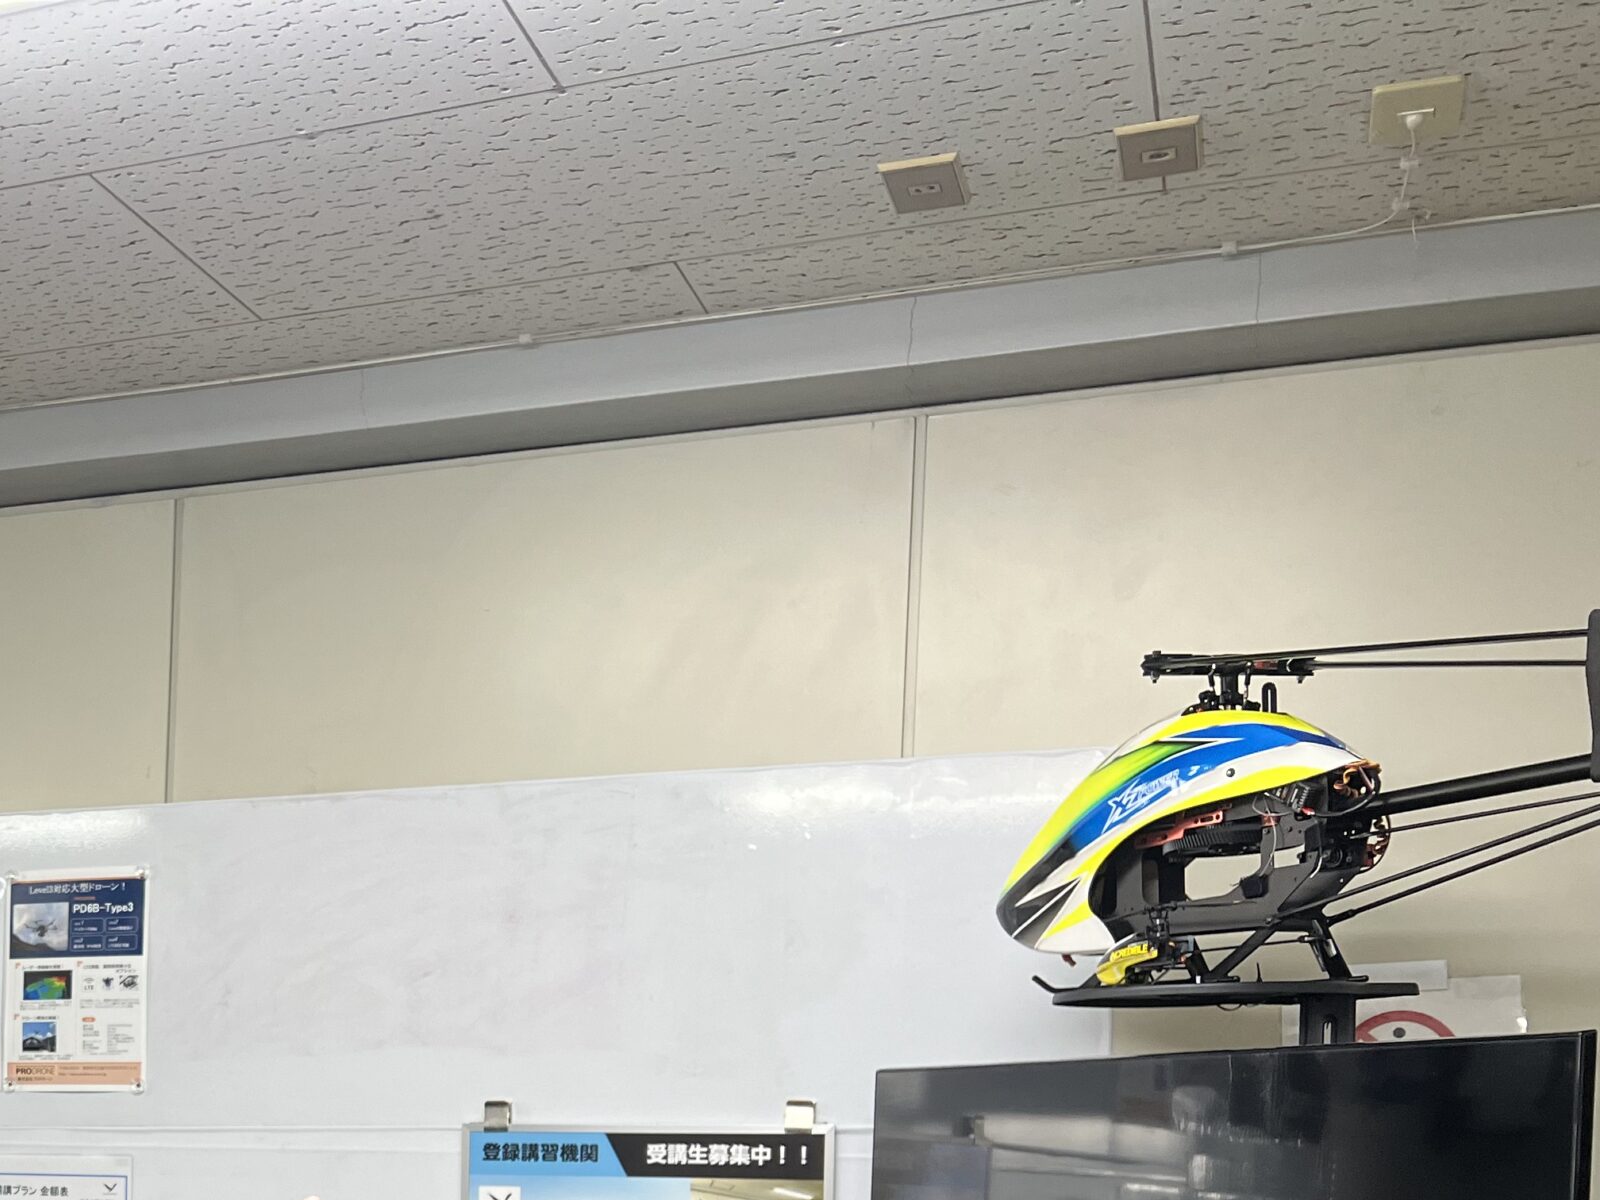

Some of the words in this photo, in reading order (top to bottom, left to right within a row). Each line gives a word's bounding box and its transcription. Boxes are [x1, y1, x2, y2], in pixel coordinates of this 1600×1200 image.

[73, 902, 134, 914] PD6B-Type3
[482, 1143, 599, 1163] 登録講習機関
[646, 1142, 808, 1166] 受講生募集中！！
[41, 1186, 69, 1197] 金額表
